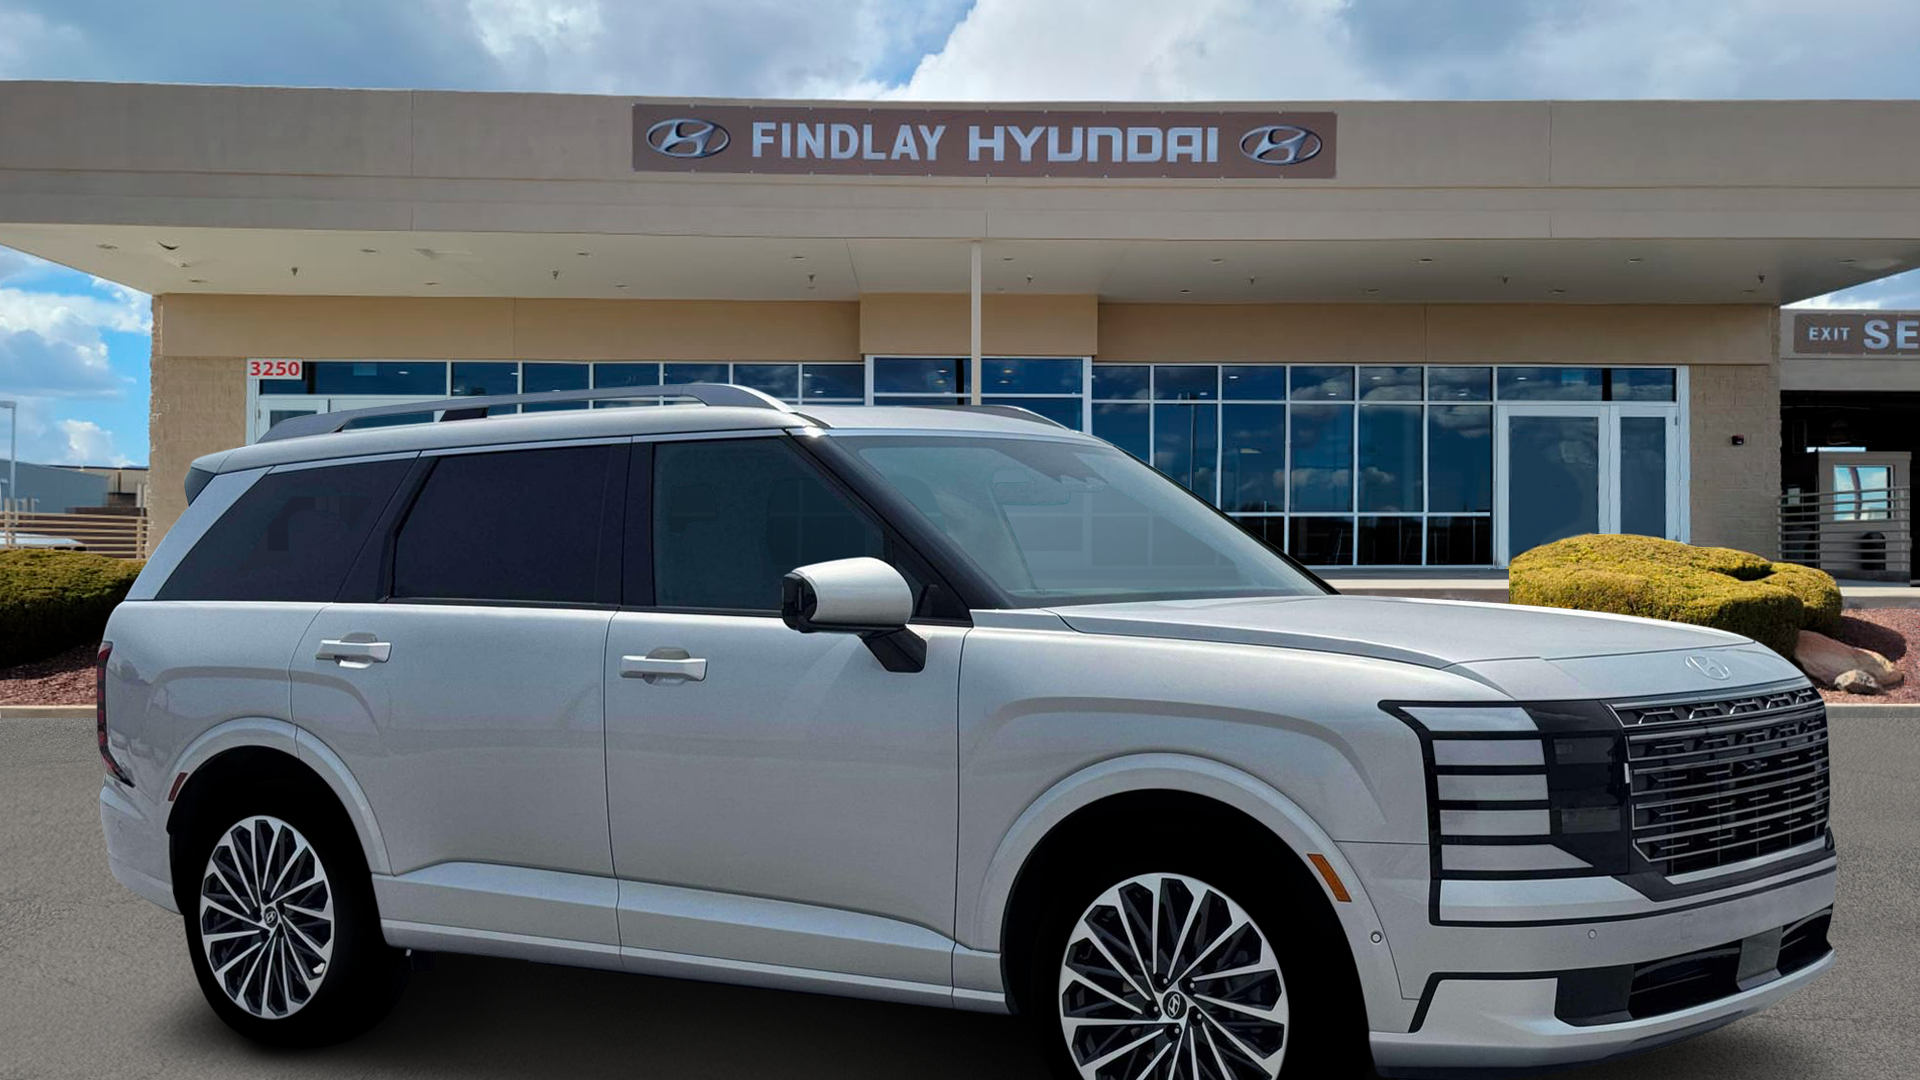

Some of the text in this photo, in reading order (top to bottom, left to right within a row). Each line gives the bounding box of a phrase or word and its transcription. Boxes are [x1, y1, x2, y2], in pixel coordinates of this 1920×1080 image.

[752, 122, 1218, 162] FINDLAY HYUNDAI
[1809, 319, 1919, 349] EXIT SE
[249, 361, 300, 376] 3250
